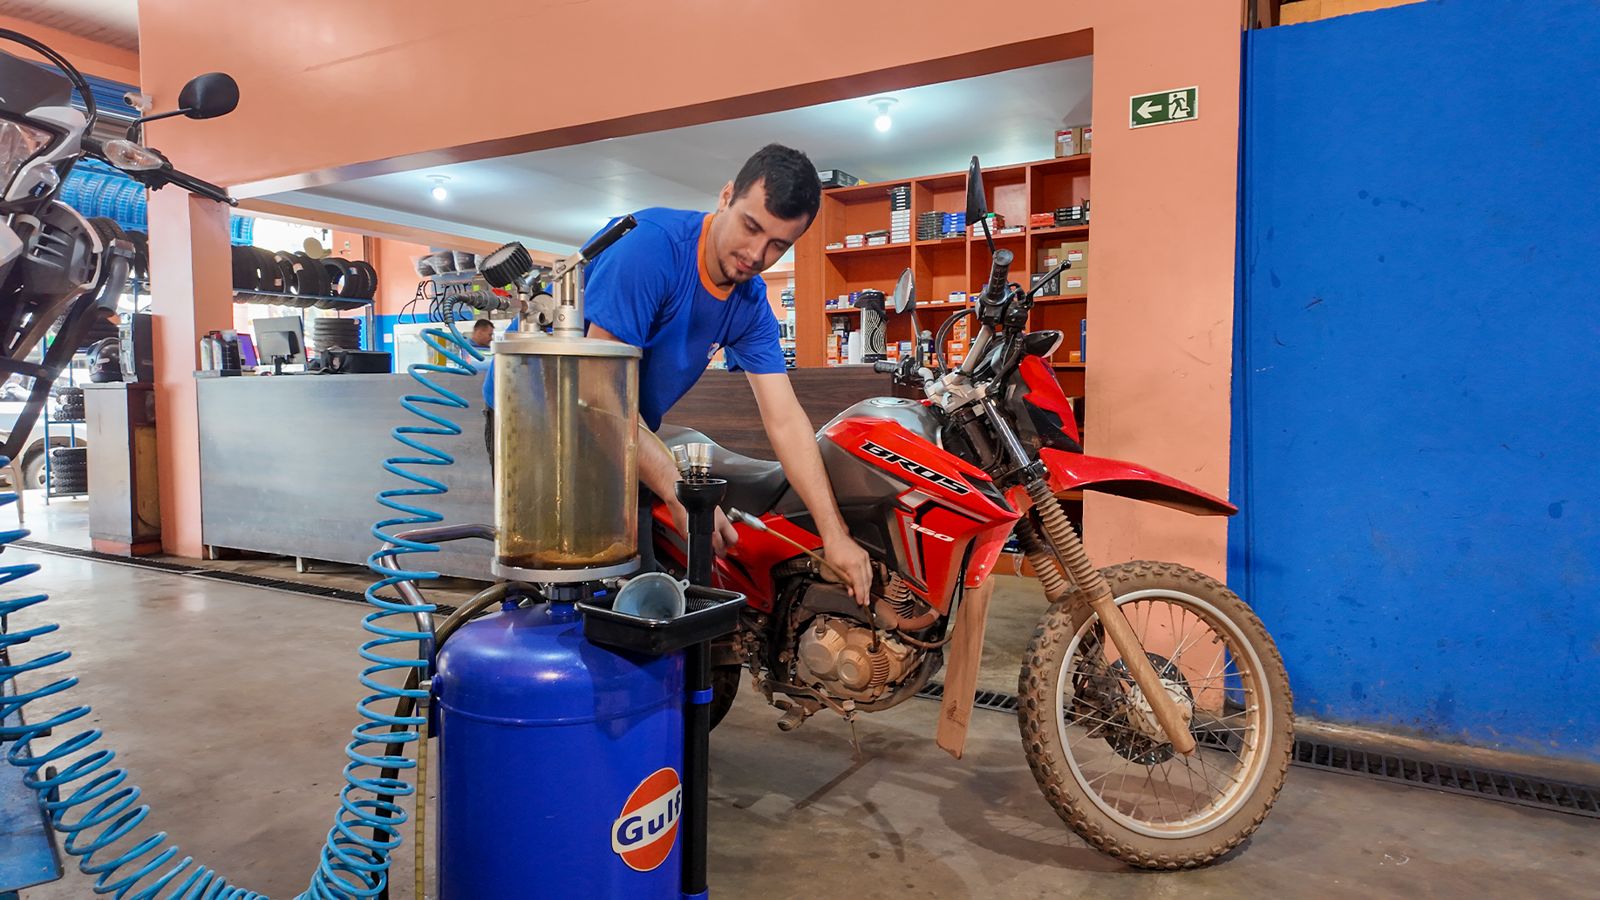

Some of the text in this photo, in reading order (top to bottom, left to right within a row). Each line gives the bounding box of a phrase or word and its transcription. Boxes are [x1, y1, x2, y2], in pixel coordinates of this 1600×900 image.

[860, 440, 971, 495] BROS
[909, 522, 955, 542] 160
[616, 790, 681, 846] Gulf
